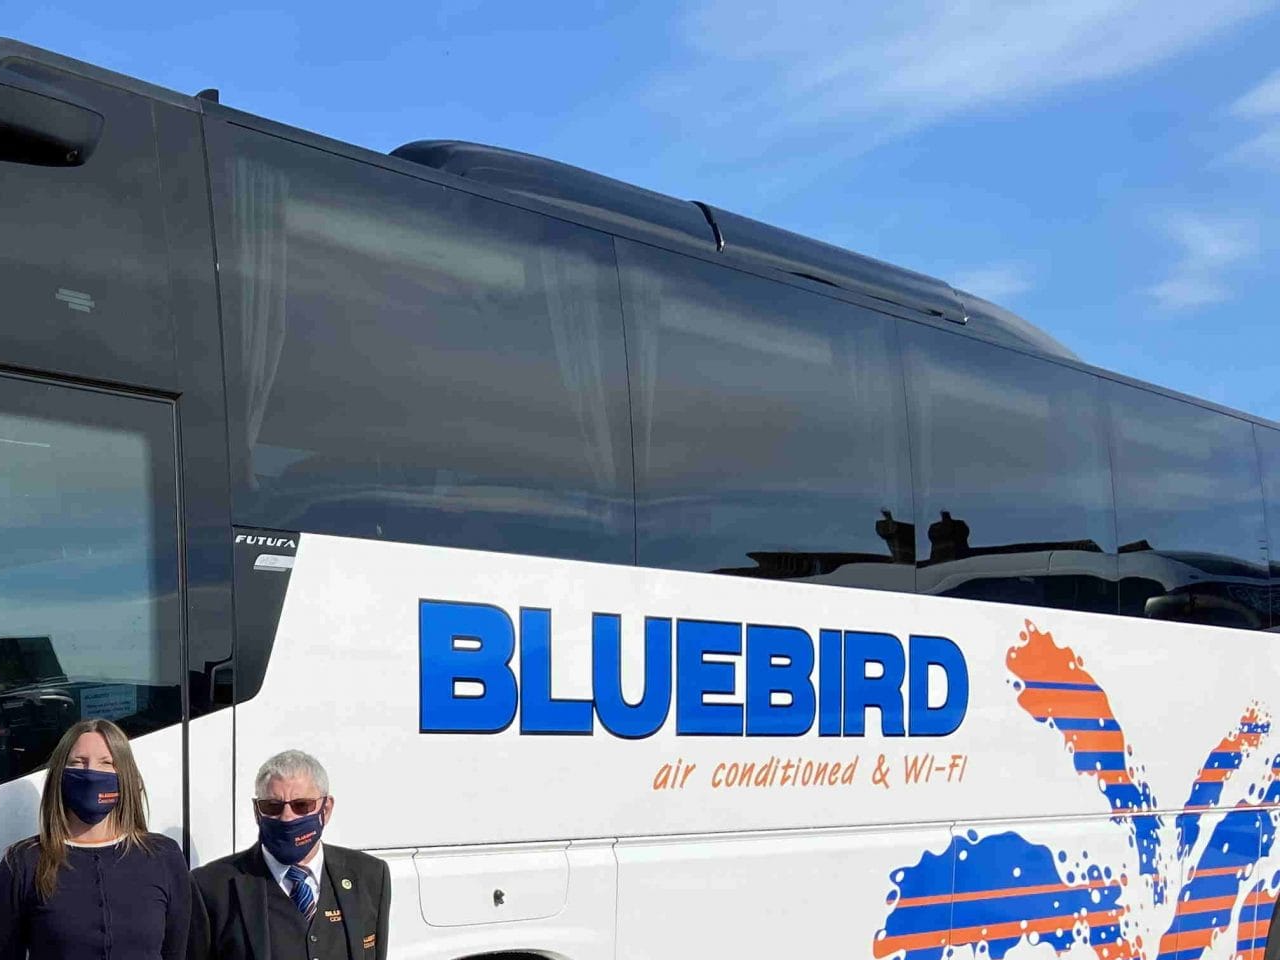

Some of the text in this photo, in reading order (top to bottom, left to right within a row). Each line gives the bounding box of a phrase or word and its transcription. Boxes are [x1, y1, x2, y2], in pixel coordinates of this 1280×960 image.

[235, 534, 297, 548] FUTURA
[419, 598, 970, 740] BLUEBIRD
[653, 757, 697, 790] air
[711, 755, 859, 788] conditioned
[871, 753, 890, 789] &
